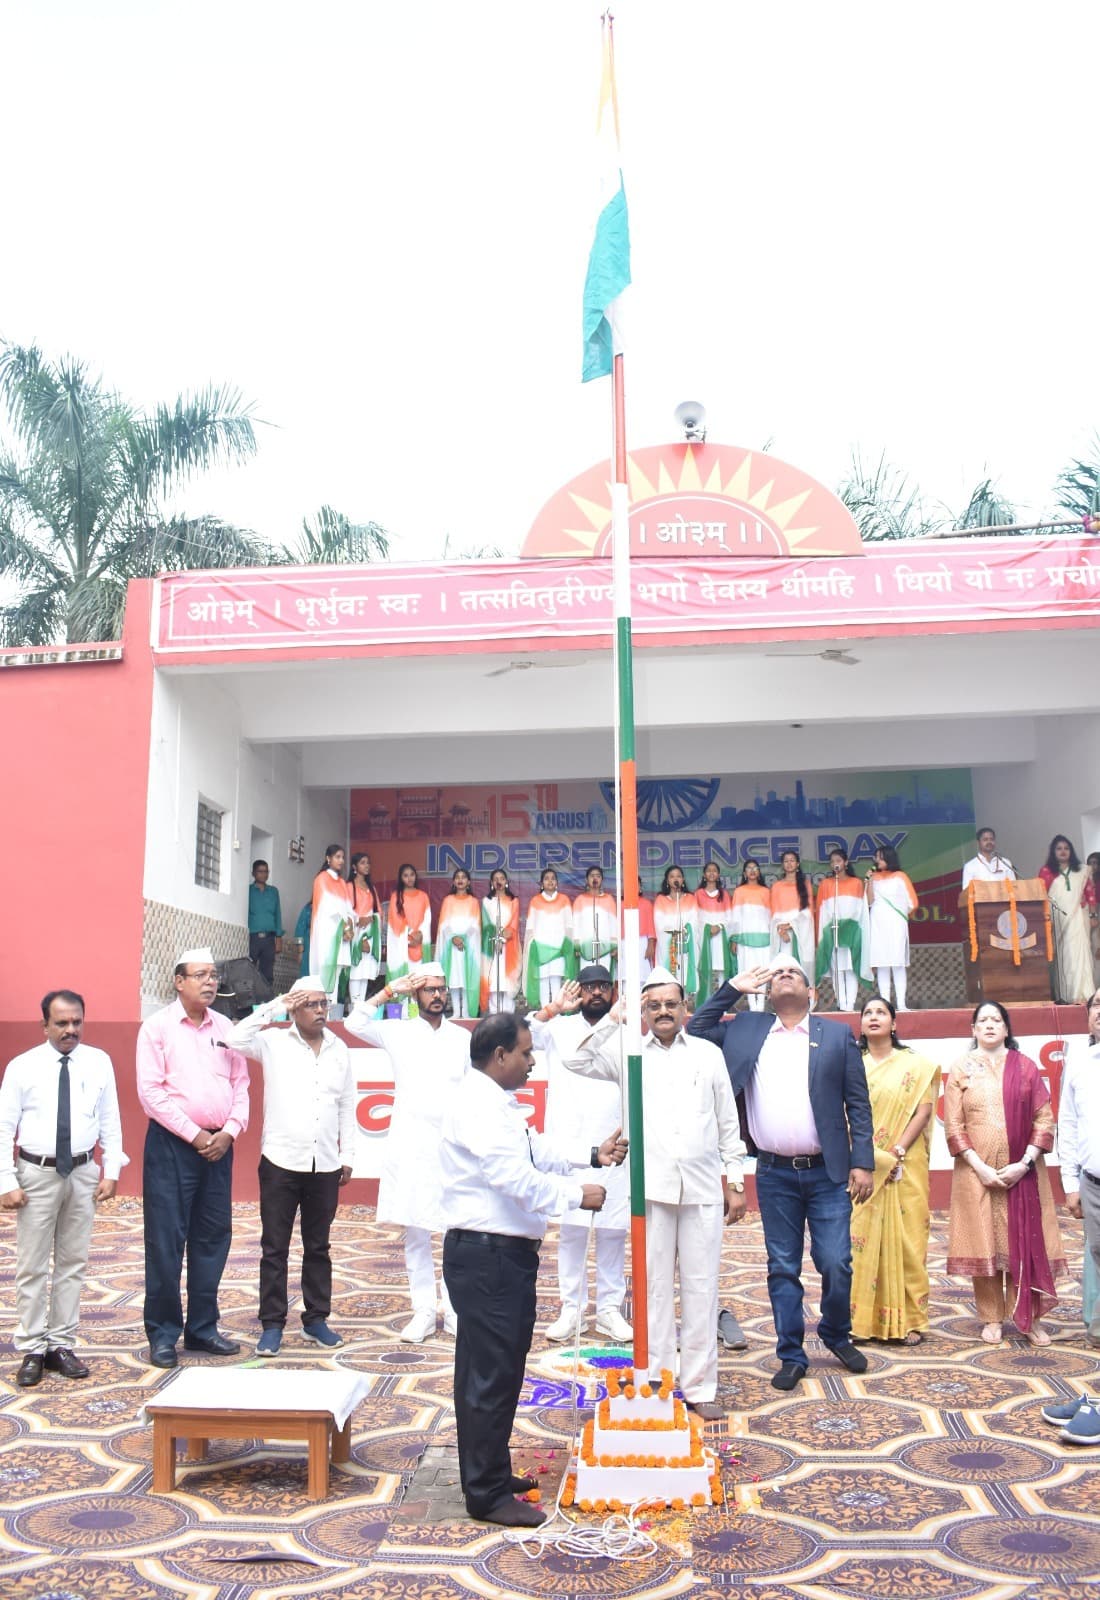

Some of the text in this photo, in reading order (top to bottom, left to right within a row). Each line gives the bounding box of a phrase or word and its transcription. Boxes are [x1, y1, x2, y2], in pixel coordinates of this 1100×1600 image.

[296, 588, 369, 626] भूर्भुवः
[377, 593, 422, 616] स्वः
[637, 573, 688, 603] भर्गो
[700, 573, 769, 603] देवस्य
[781, 568, 855, 598] धीमहि
[894, 563, 952, 592] धियो
[963, 561, 993, 589] यो
[1004, 568, 1036, 588] नः
[1045, 556, 1100, 586] प्रचो
[535, 811, 592, 830] AUGUST
[816, 831, 907, 863] DAY
